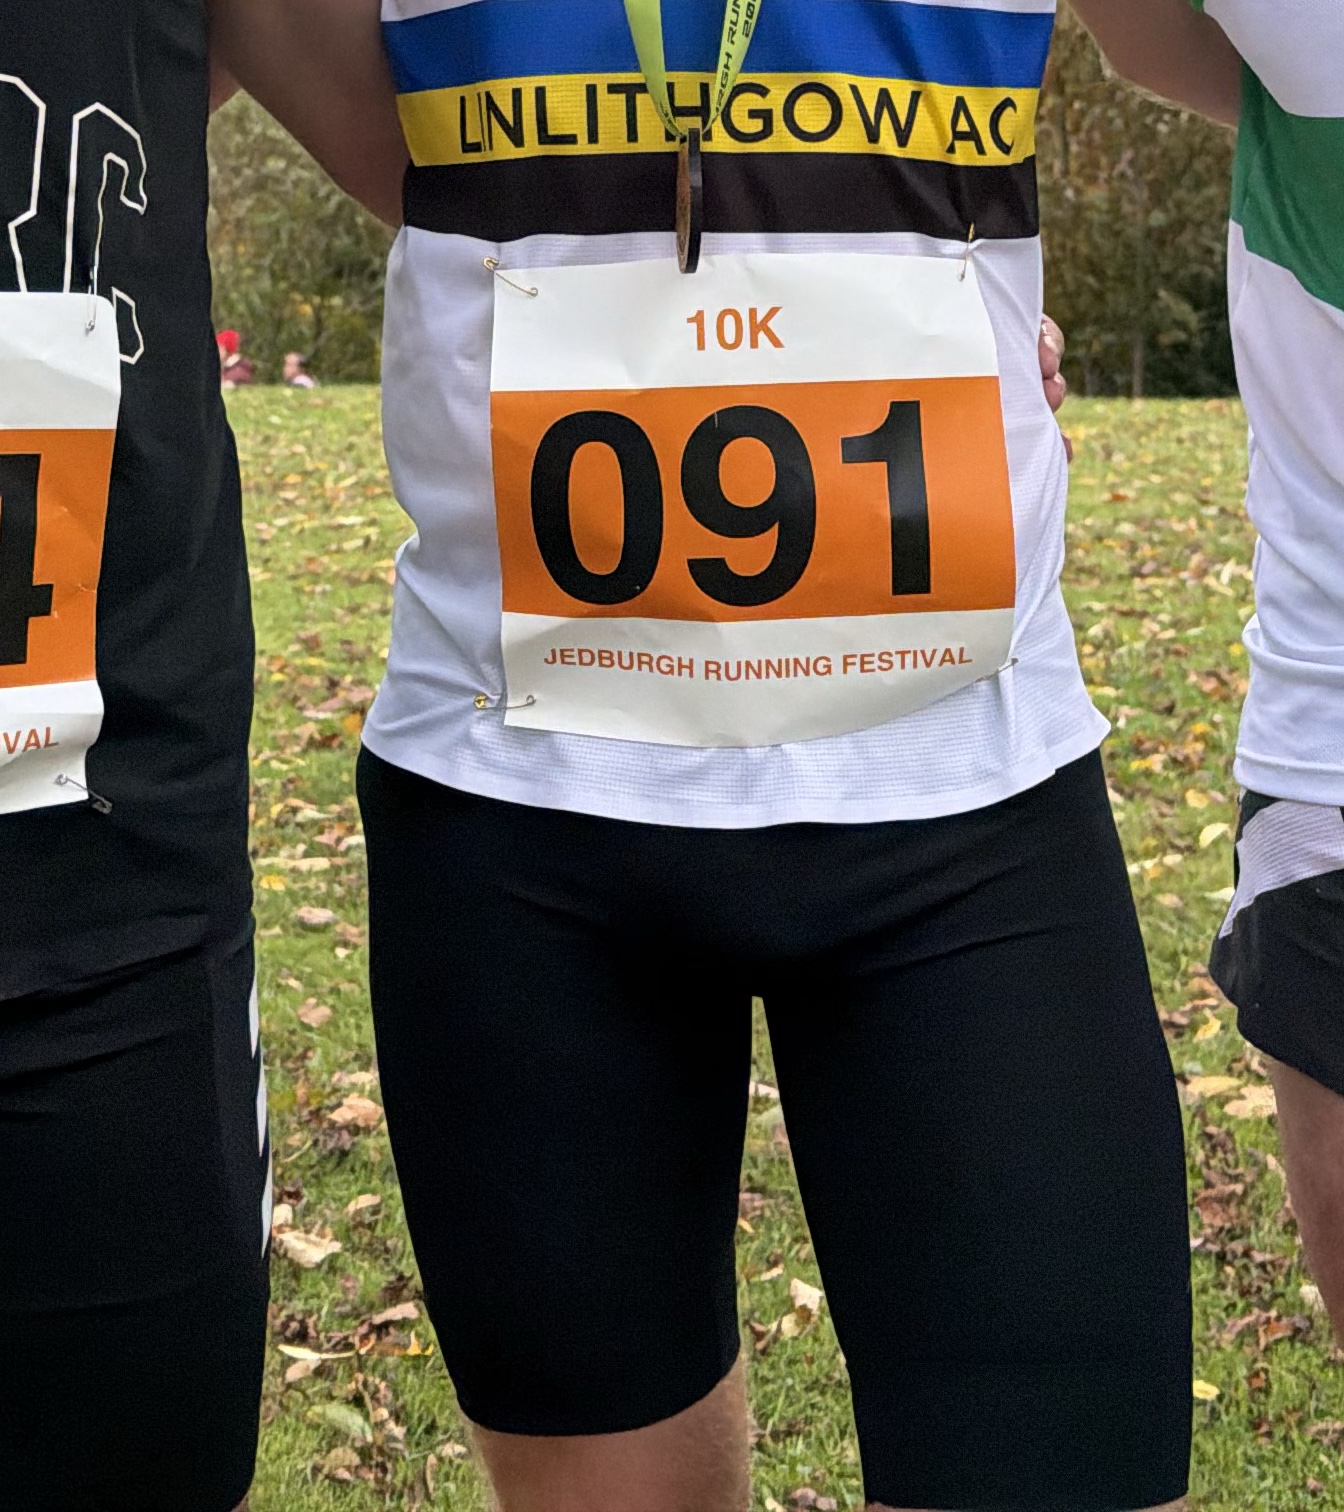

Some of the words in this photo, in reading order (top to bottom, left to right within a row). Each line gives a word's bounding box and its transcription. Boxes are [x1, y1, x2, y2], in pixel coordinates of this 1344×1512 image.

[945, 96, 1017, 156] AC
[687, 306, 785, 351] 10K
[530, 399, 931, 607] 091
[544, 648, 694, 678] JEDBURGH
[704, 656, 832, 681] RUNNING
[842, 647, 973, 674] FESTIVAL
